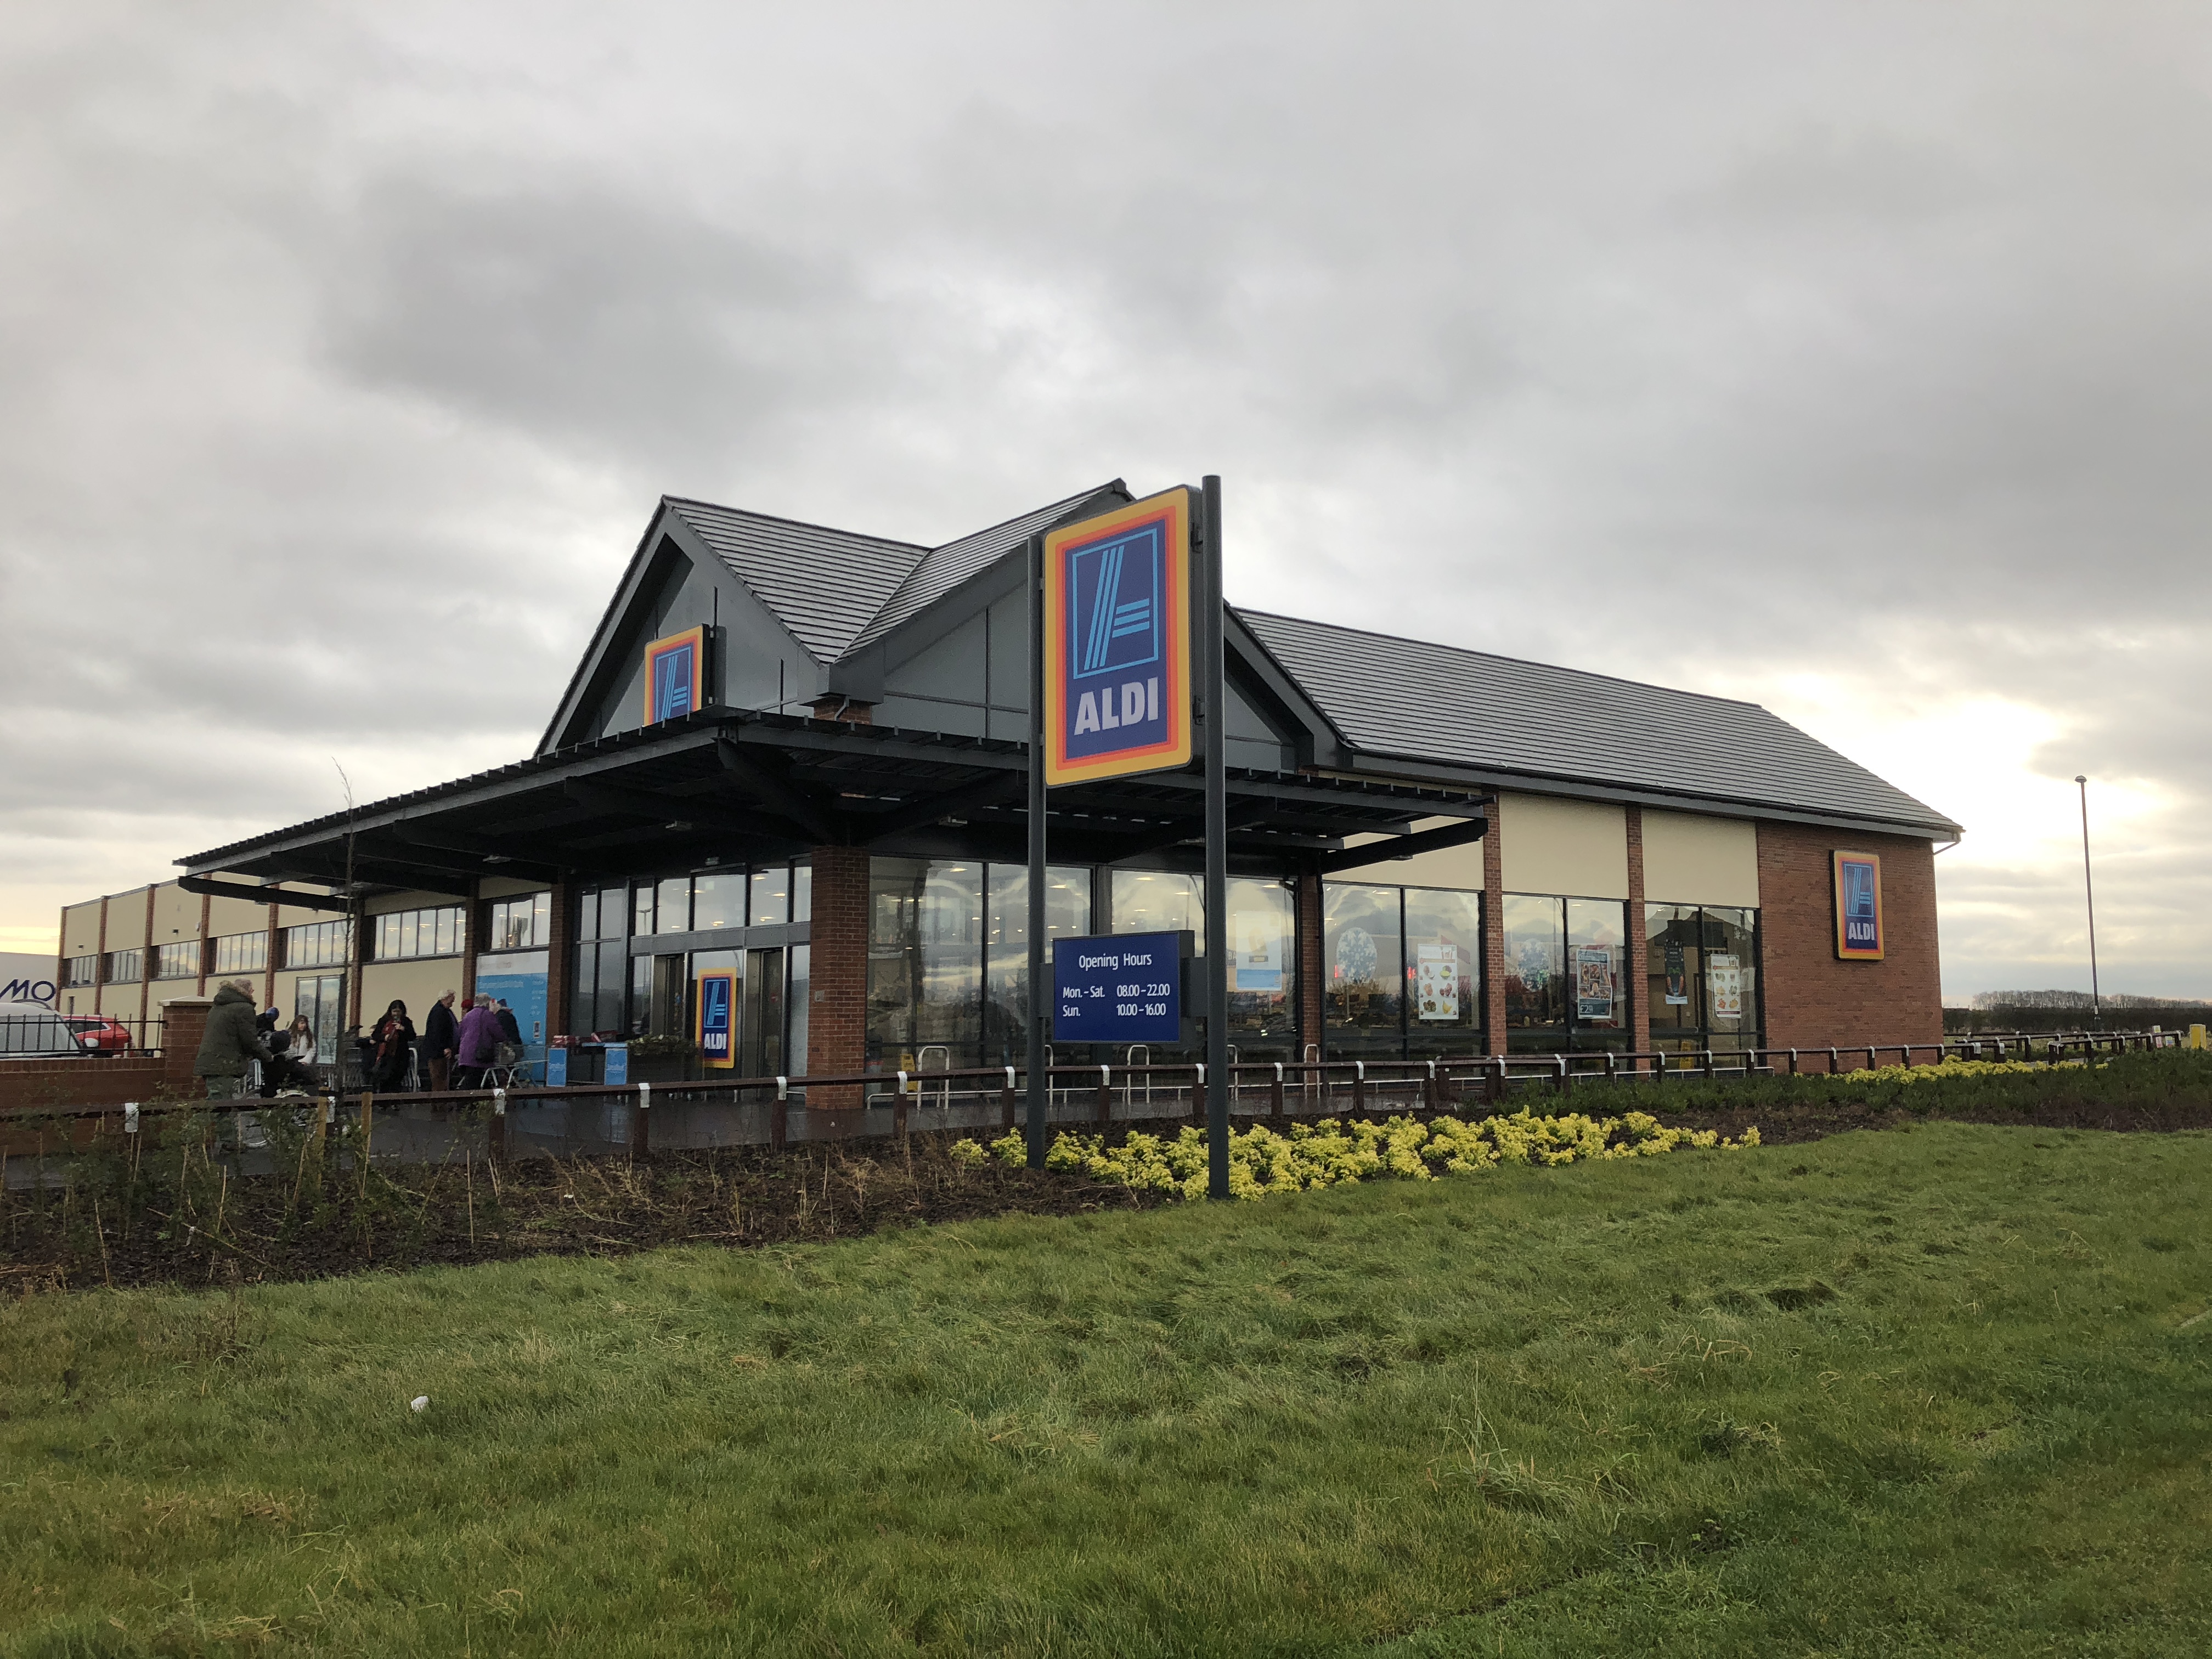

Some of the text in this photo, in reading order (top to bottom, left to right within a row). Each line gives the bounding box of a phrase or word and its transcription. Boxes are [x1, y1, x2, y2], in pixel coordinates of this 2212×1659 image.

[1074, 676, 1158, 736] ALDI
[1848, 922, 1875, 941] ALDI
[1079, 952, 1152, 971] Opening Hours
[1063, 1005, 1081, 1017] Sun.
[704, 1033, 727, 1050] ALDI
